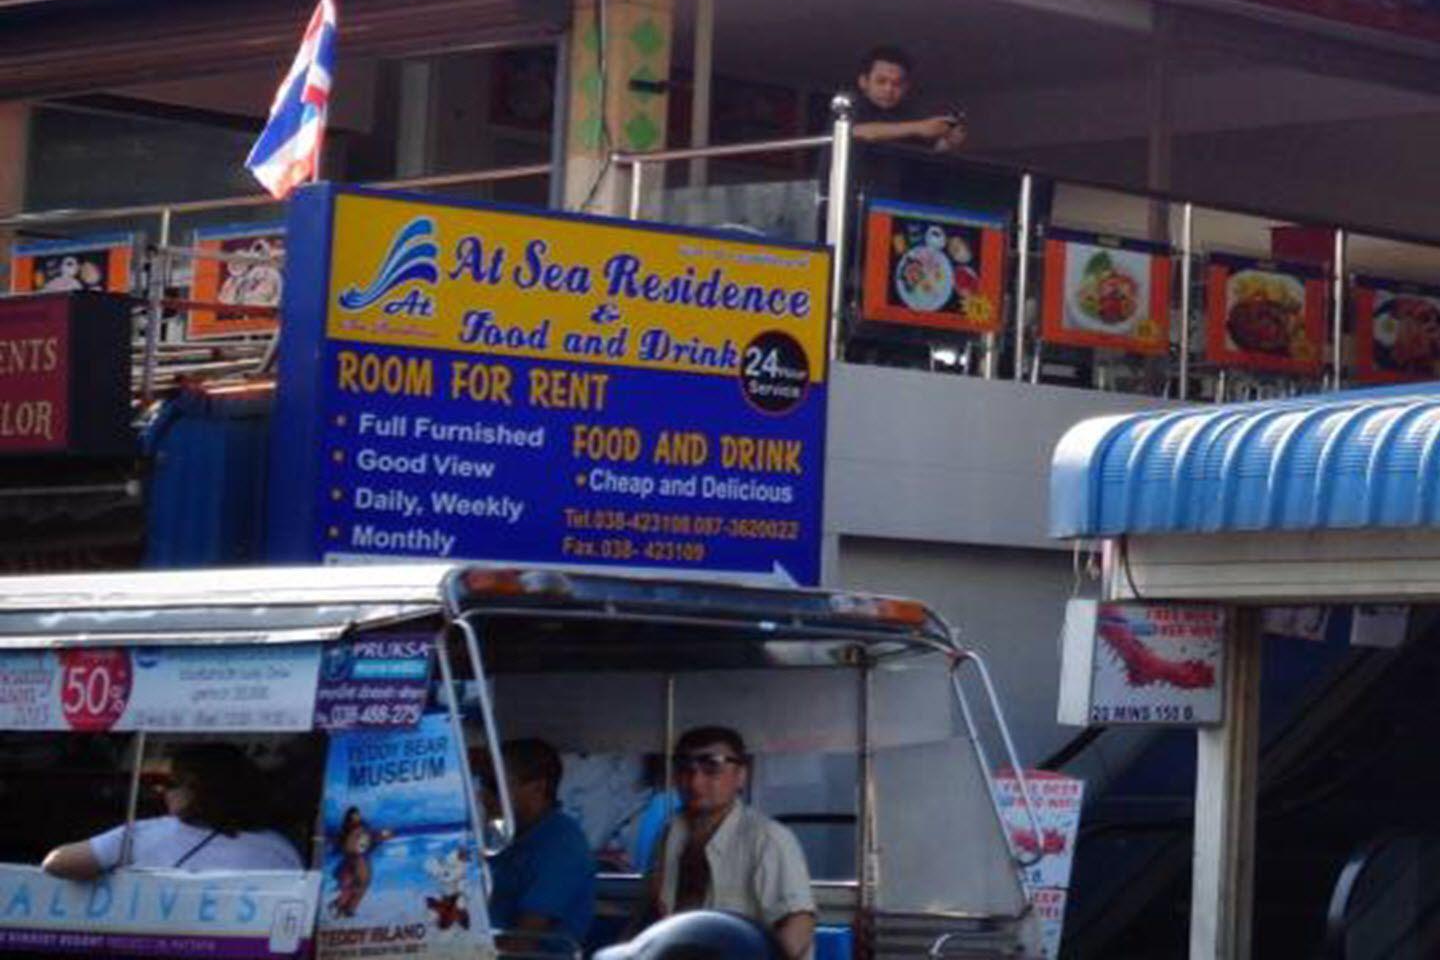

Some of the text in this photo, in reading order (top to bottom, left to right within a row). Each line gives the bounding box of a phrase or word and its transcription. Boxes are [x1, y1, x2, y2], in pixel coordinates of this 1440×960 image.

[449, 235, 505, 286] At
[513, 238, 591, 295] Sea
[602, 253, 812, 319] Residence
[589, 302, 622, 326] &
[458, 309, 552, 352] Food
[562, 326, 630, 358] and
[637, 327, 743, 369] Drink
[337, 350, 610, 411] ROOM FOR RENT
[745, 346, 777, 379] 24
[358, 413, 546, 449] Full Furnished
[356, 448, 496, 478] Good View
[572, 424, 804, 476] FOOD AND DRINK
[589, 468, 795, 505] Cheap and Delicious
[354, 487, 525, 525] Daily, Weekly
[351, 524, 456, 558] Monthly
[350, 756, 446, 788] MUSEUM
[4, 878, 258, 923] ALDIVES
